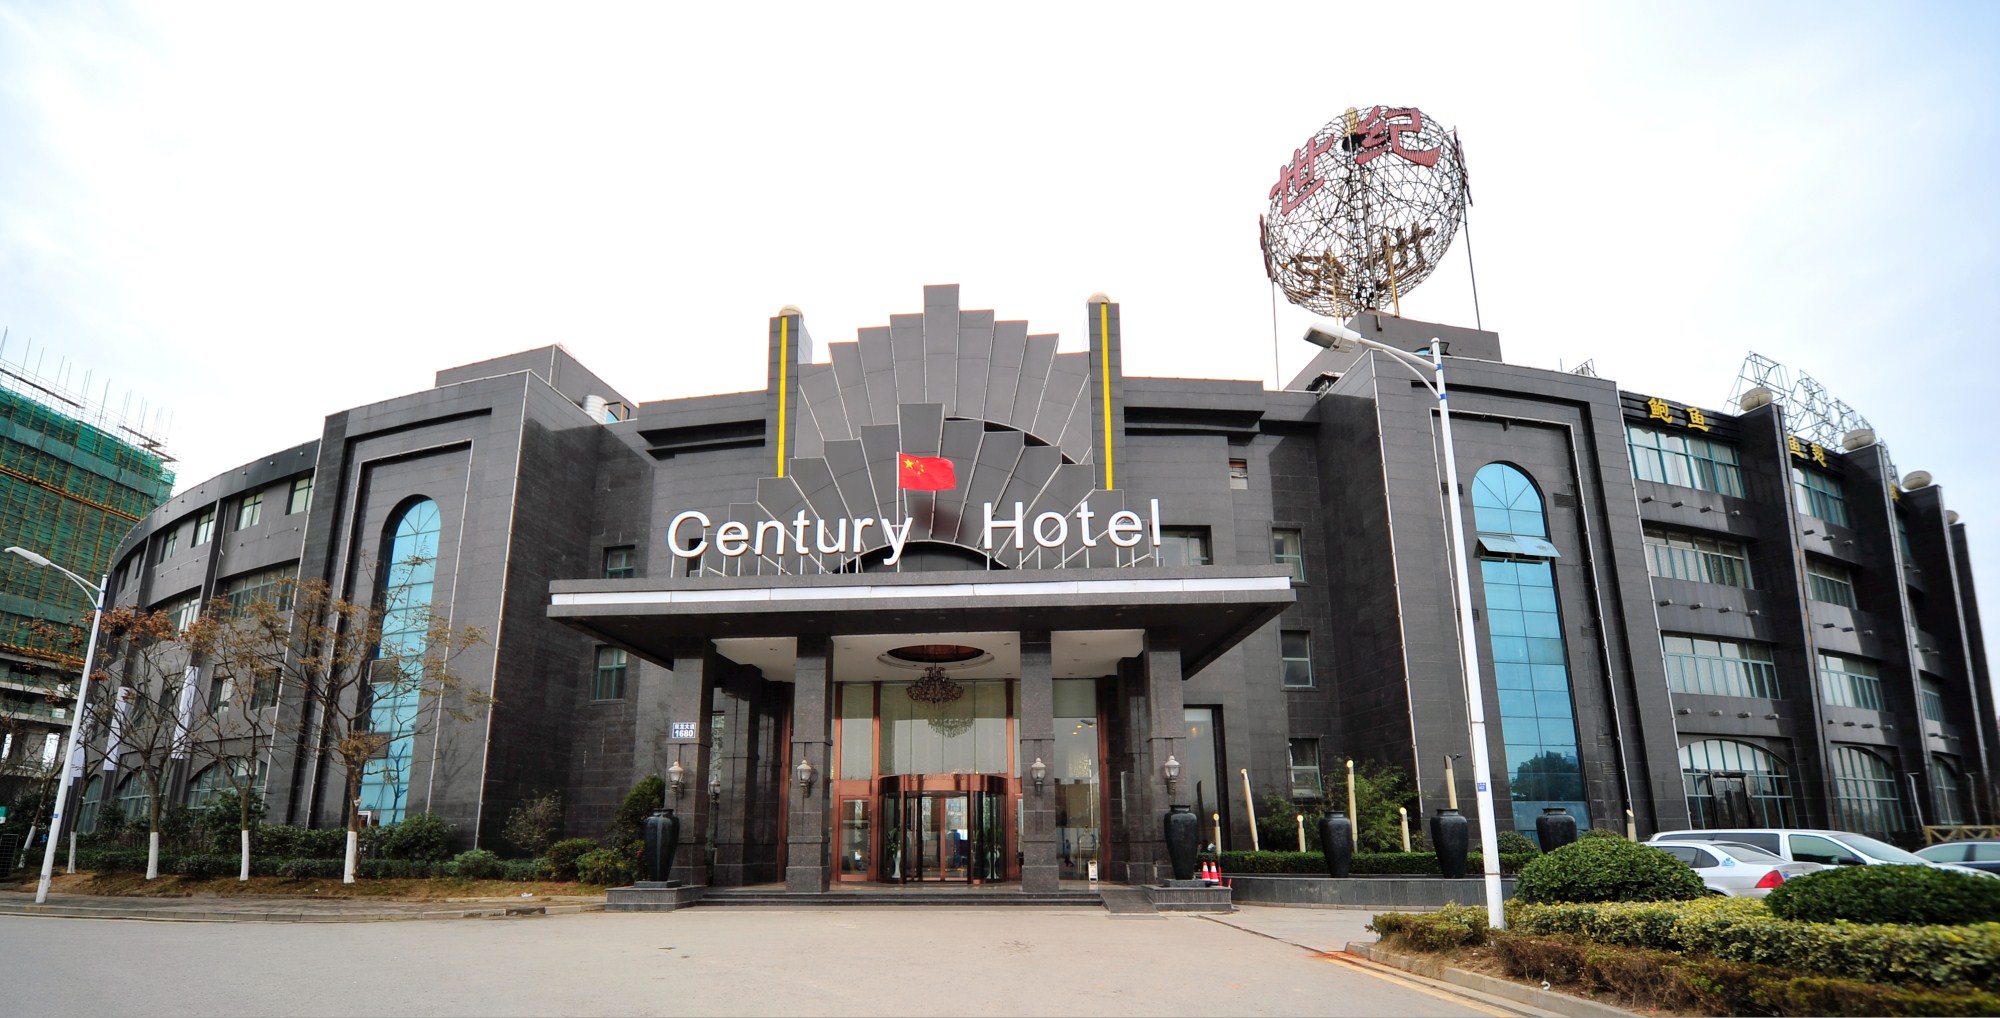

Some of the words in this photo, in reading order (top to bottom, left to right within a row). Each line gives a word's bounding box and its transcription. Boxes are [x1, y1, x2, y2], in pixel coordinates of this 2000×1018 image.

[1269, 105, 1441, 216] 世纪
[1647, 397, 1709, 432] 鲍鱼
[667, 509, 914, 566] Century
[982, 498, 1162, 550] Hotel
[674, 729, 694, 737] 1680
